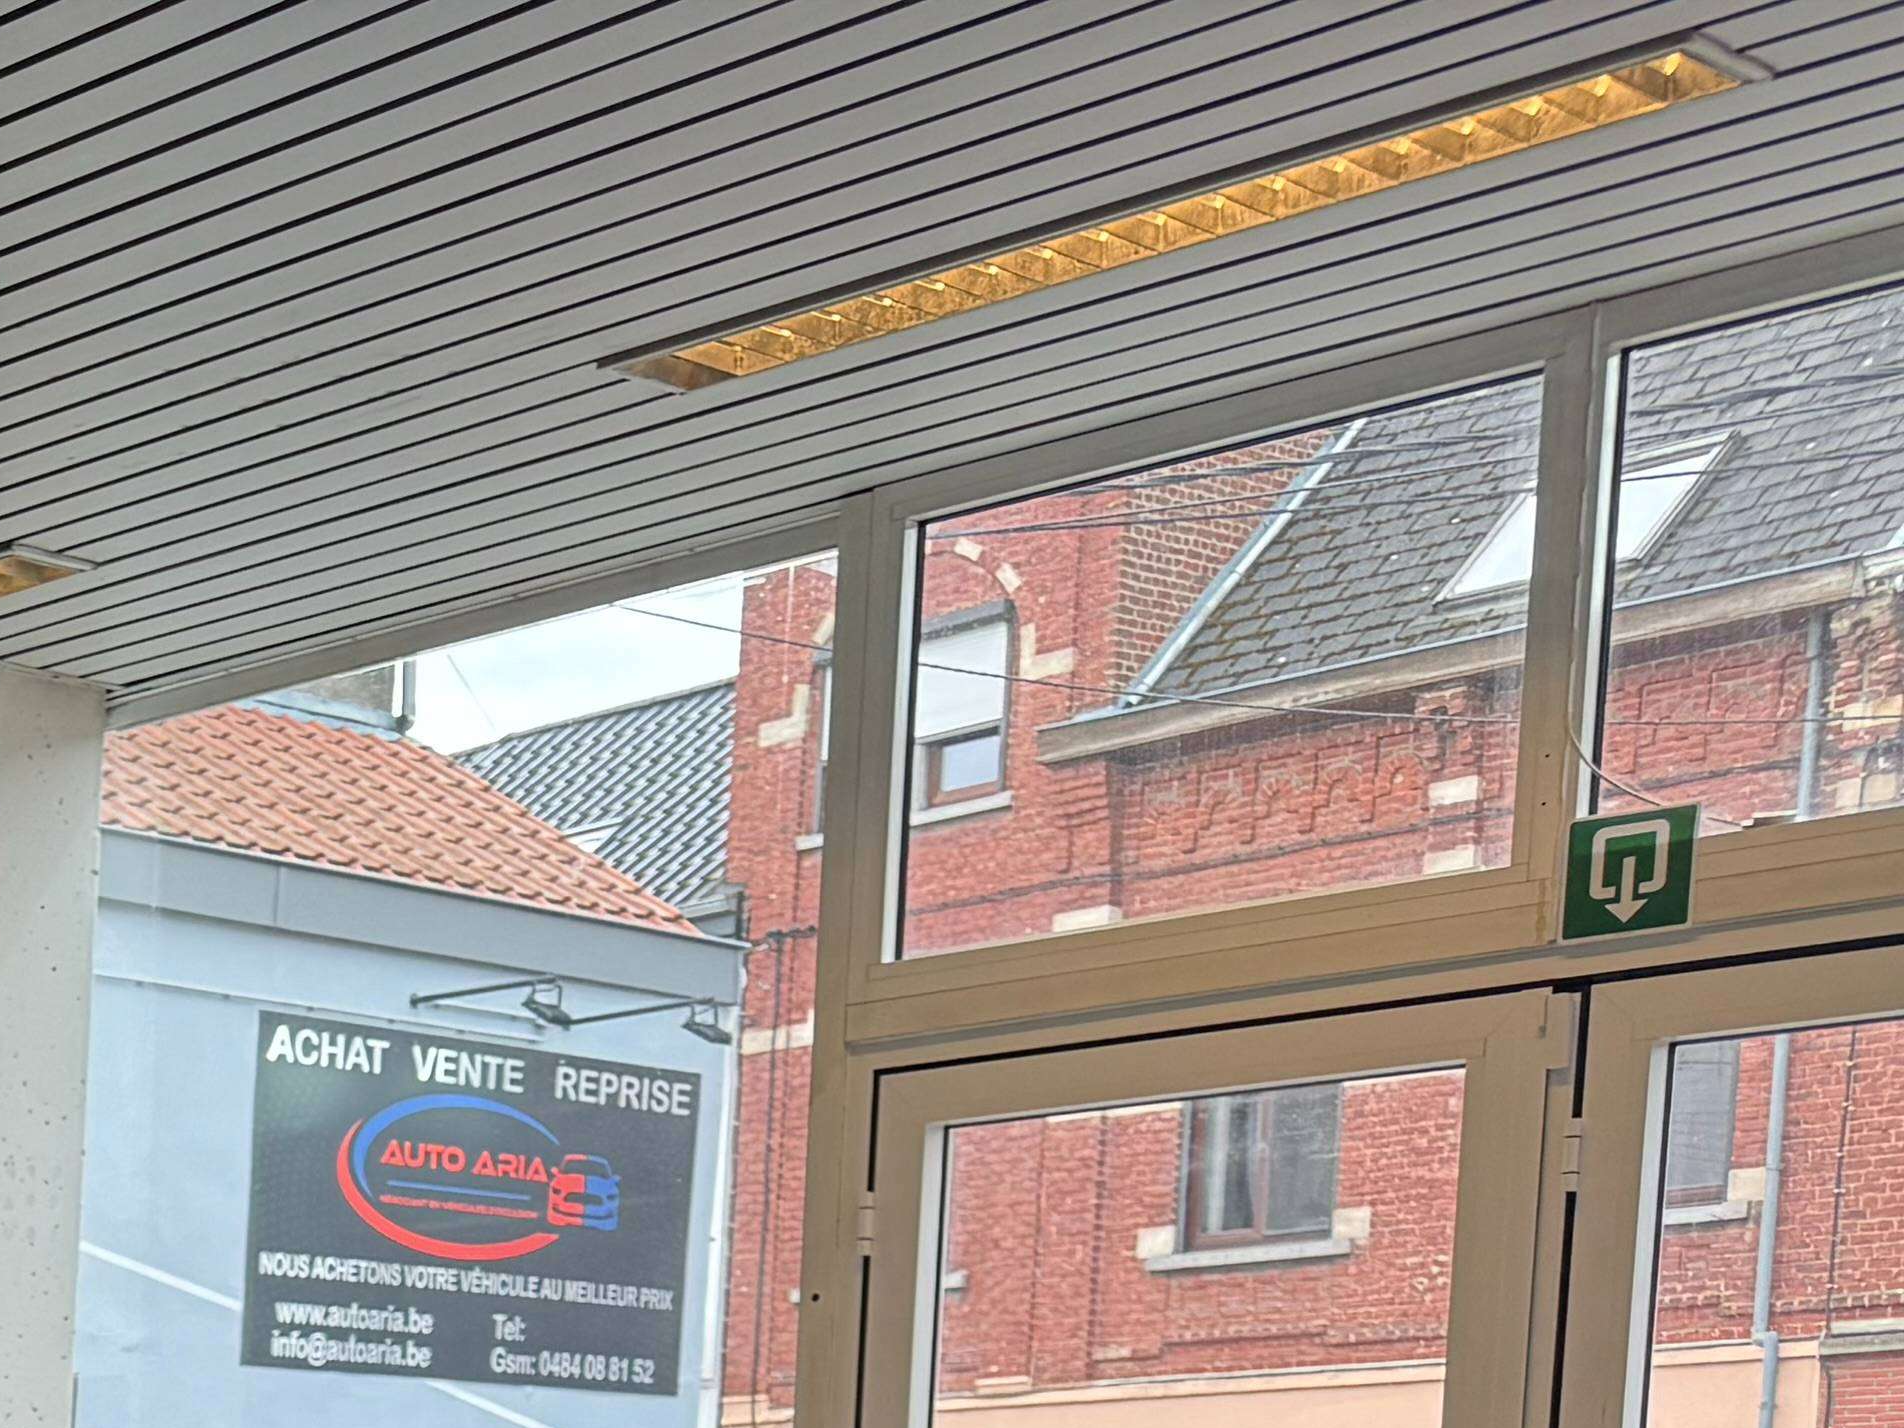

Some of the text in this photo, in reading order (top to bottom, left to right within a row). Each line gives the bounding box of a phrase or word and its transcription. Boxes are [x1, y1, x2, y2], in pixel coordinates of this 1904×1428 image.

[266, 1024, 692, 1116] ACHAT VENTE REPRISE
[380, 1138, 549, 1183] AUTO ARIA
[259, 1252, 673, 1310] NOUS ACHETONS VOTRE VÉHICULE AU MEILLEUR PRIX
[275, 1300, 434, 1335] www.autoaria.be
[270, 1330, 432, 1368] info@autoaria.be
[490, 1346, 536, 1376] Gsm:
[538, 1350, 585, 1380] 0484
[607, 1357, 629, 1382] 81
[631, 1358, 655, 1384] 52
